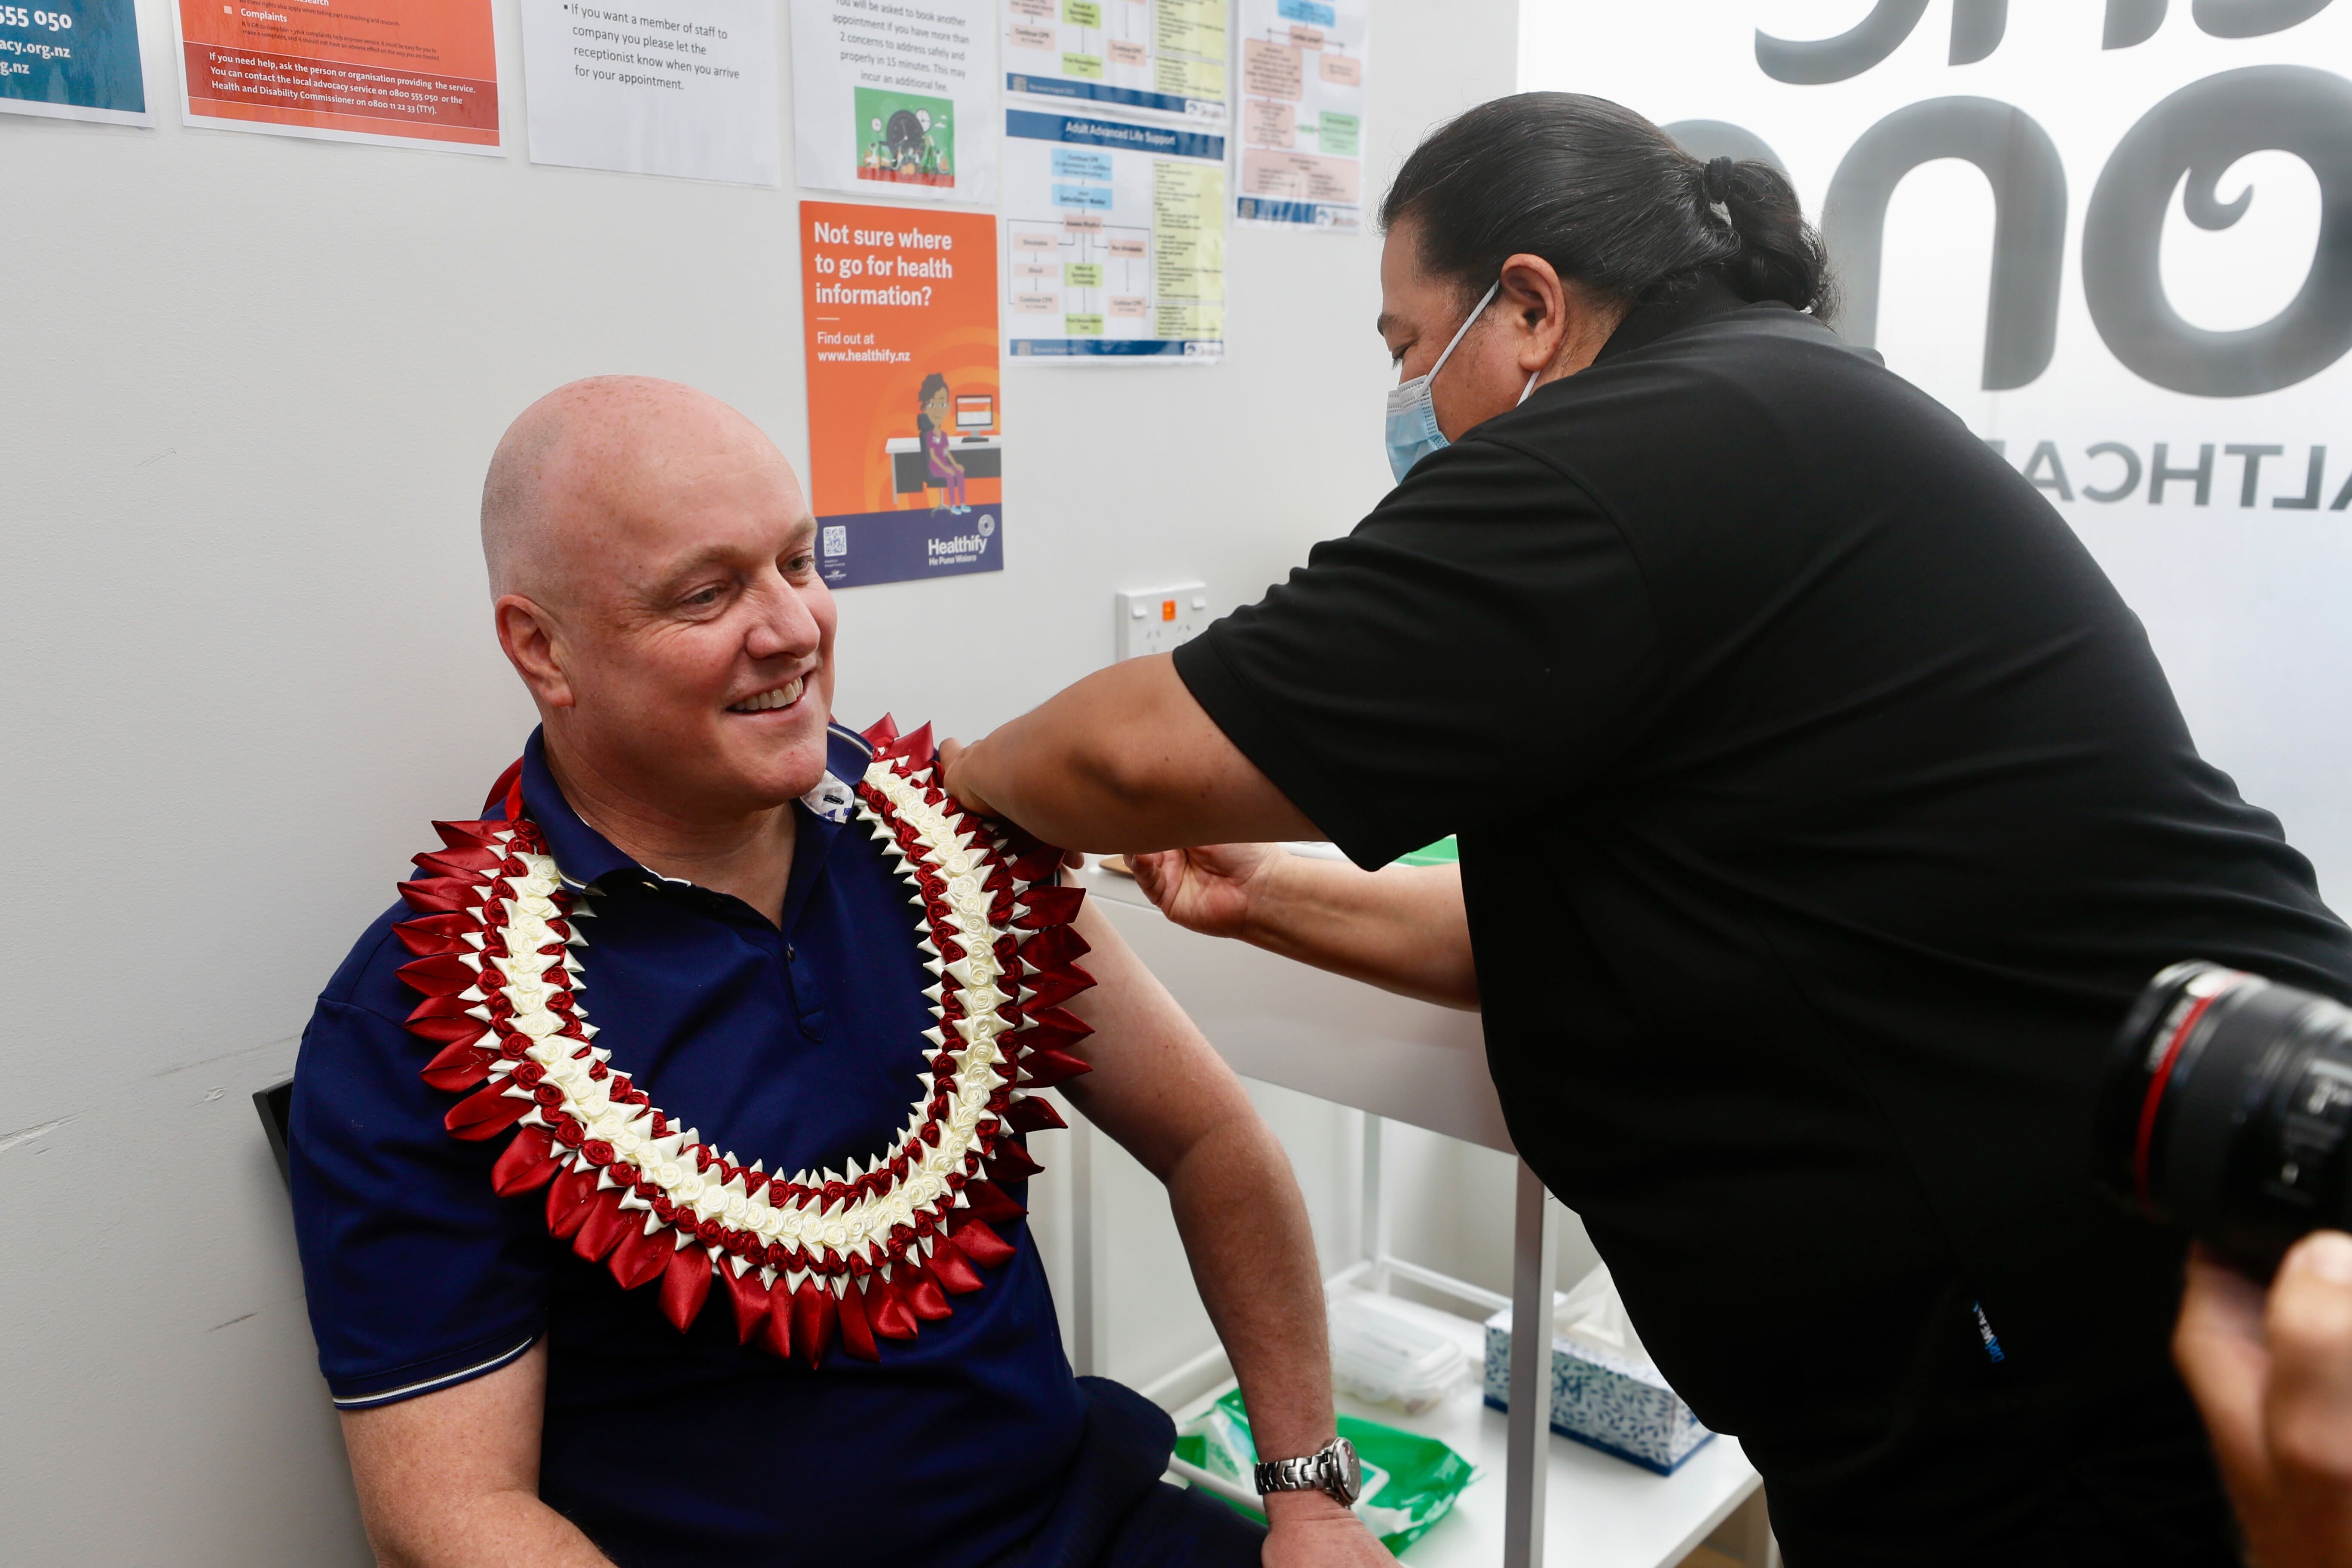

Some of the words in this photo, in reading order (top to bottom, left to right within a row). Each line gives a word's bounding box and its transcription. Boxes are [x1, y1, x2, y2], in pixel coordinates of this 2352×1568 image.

[34, 10, 72, 31] 050
[241, 8, 287, 21] Complaints
[572, 3, 578, 14] If
[581, 8, 600, 18] you
[603, 12, 628, 23] want
[631, 16, 637, 24] a
[640, 18, 680, 31] member
[683, 23, 692, 33] of
[695, 26, 715, 37] staff
[717, 29, 727, 39] to
[853, 0, 867, 9] will
[869, 1, 879, 11] be
[881, 5, 903, 15] asked
[905, 9, 914, 17] to
[916, 10, 934, 21] book
[936, 15, 966, 26] another
[573, 27, 619, 43] company
[622, 34, 640, 44] you
[643, 36, 674, 49] please
[677, 40, 689, 52] let
[691, 43, 706, 55] the
[833, 15, 885, 30] appointment
[887, 21, 892, 31] if
[894, 26, 909, 34] you
[910, 26, 929, 37] have
[931, 31, 951, 41] more
[952, 34, 970, 43] than
[0, 40, 70, 58] acy.org.nz
[840, 31, 845, 41] 2
[847, 35, 884, 47] concerns
[885, 40, 894, 49] to
[896, 42, 926, 54] address
[928, 47, 949, 59] safely
[951, 52, 965, 60] and
[0, 61, 29, 75] g.nz
[217, 55, 233, 63] you
[235, 57, 255, 65] need
[257, 58, 278, 70] help,
[279, 62, 292, 70] ask
[294, 63, 308, 72] the
[310, 67, 336, 75] person
[348, 72, 395, 83] organisation
[397, 78, 432, 89] providing
[435, 81, 447, 89] the
[449, 84, 475, 92] service.
[574, 47, 634, 63] receptionist
[637, 54, 663, 67] know
[666, 59, 692, 71] when
[694, 65, 711, 75] you
[714, 67, 739, 79] arrive
[840, 52, 875, 65] properly
[887, 57, 896, 67] 15
[898, 61, 931, 72] minutes.
[933, 64, 948, 74] This
[950, 68, 965, 79] may
[210, 66, 226, 75] You
[244, 73, 275, 81] contact
[277, 75, 291, 83] the
[293, 76, 311, 86] local
[313, 80, 348, 92] advocacy
[350, 86, 376, 94] service
[389, 89, 409, 98] 0800
[411, 92, 423, 101] 555
[575, 64, 589, 77] for
[592, 70, 615, 80] your
[619, 74, 683, 89] appointment.
[861, 71, 881, 81] incur
[895, 77, 933, 89] additional
[934, 81, 947, 92] fee.
[211, 80, 239, 91] Health
[260, 86, 298, 99] Disability
[300, 91, 354, 104] Commissioner
[368, 99, 388, 108] 0800
[416, 104, 436, 115] (TTY).
[1066, 122, 1088, 134] Adult
[1089, 125, 1128, 139] Advanced
[1129, 130, 1143, 141] Life
[1145, 132, 1175, 144] Support
[815, 222, 849, 244] Not
[854, 230, 894, 246] sure
[898, 228, 952, 249] where
[815, 254, 835, 273] to
[839, 259, 863, 278] go
[867, 255, 893, 275] for
[897, 257, 952, 278] health
[816, 283, 931, 305] information?
[818, 331, 841, 344] Find
[843, 334, 861, 344] out
[864, 334, 874, 344] at
[818, 349, 910, 363] www.healthify.nz
[928, 534, 987, 556] Healthify
[929, 557, 938, 566] He
[939, 557, 955, 565] Puna
[955, 554, 977, 563] Waiora
